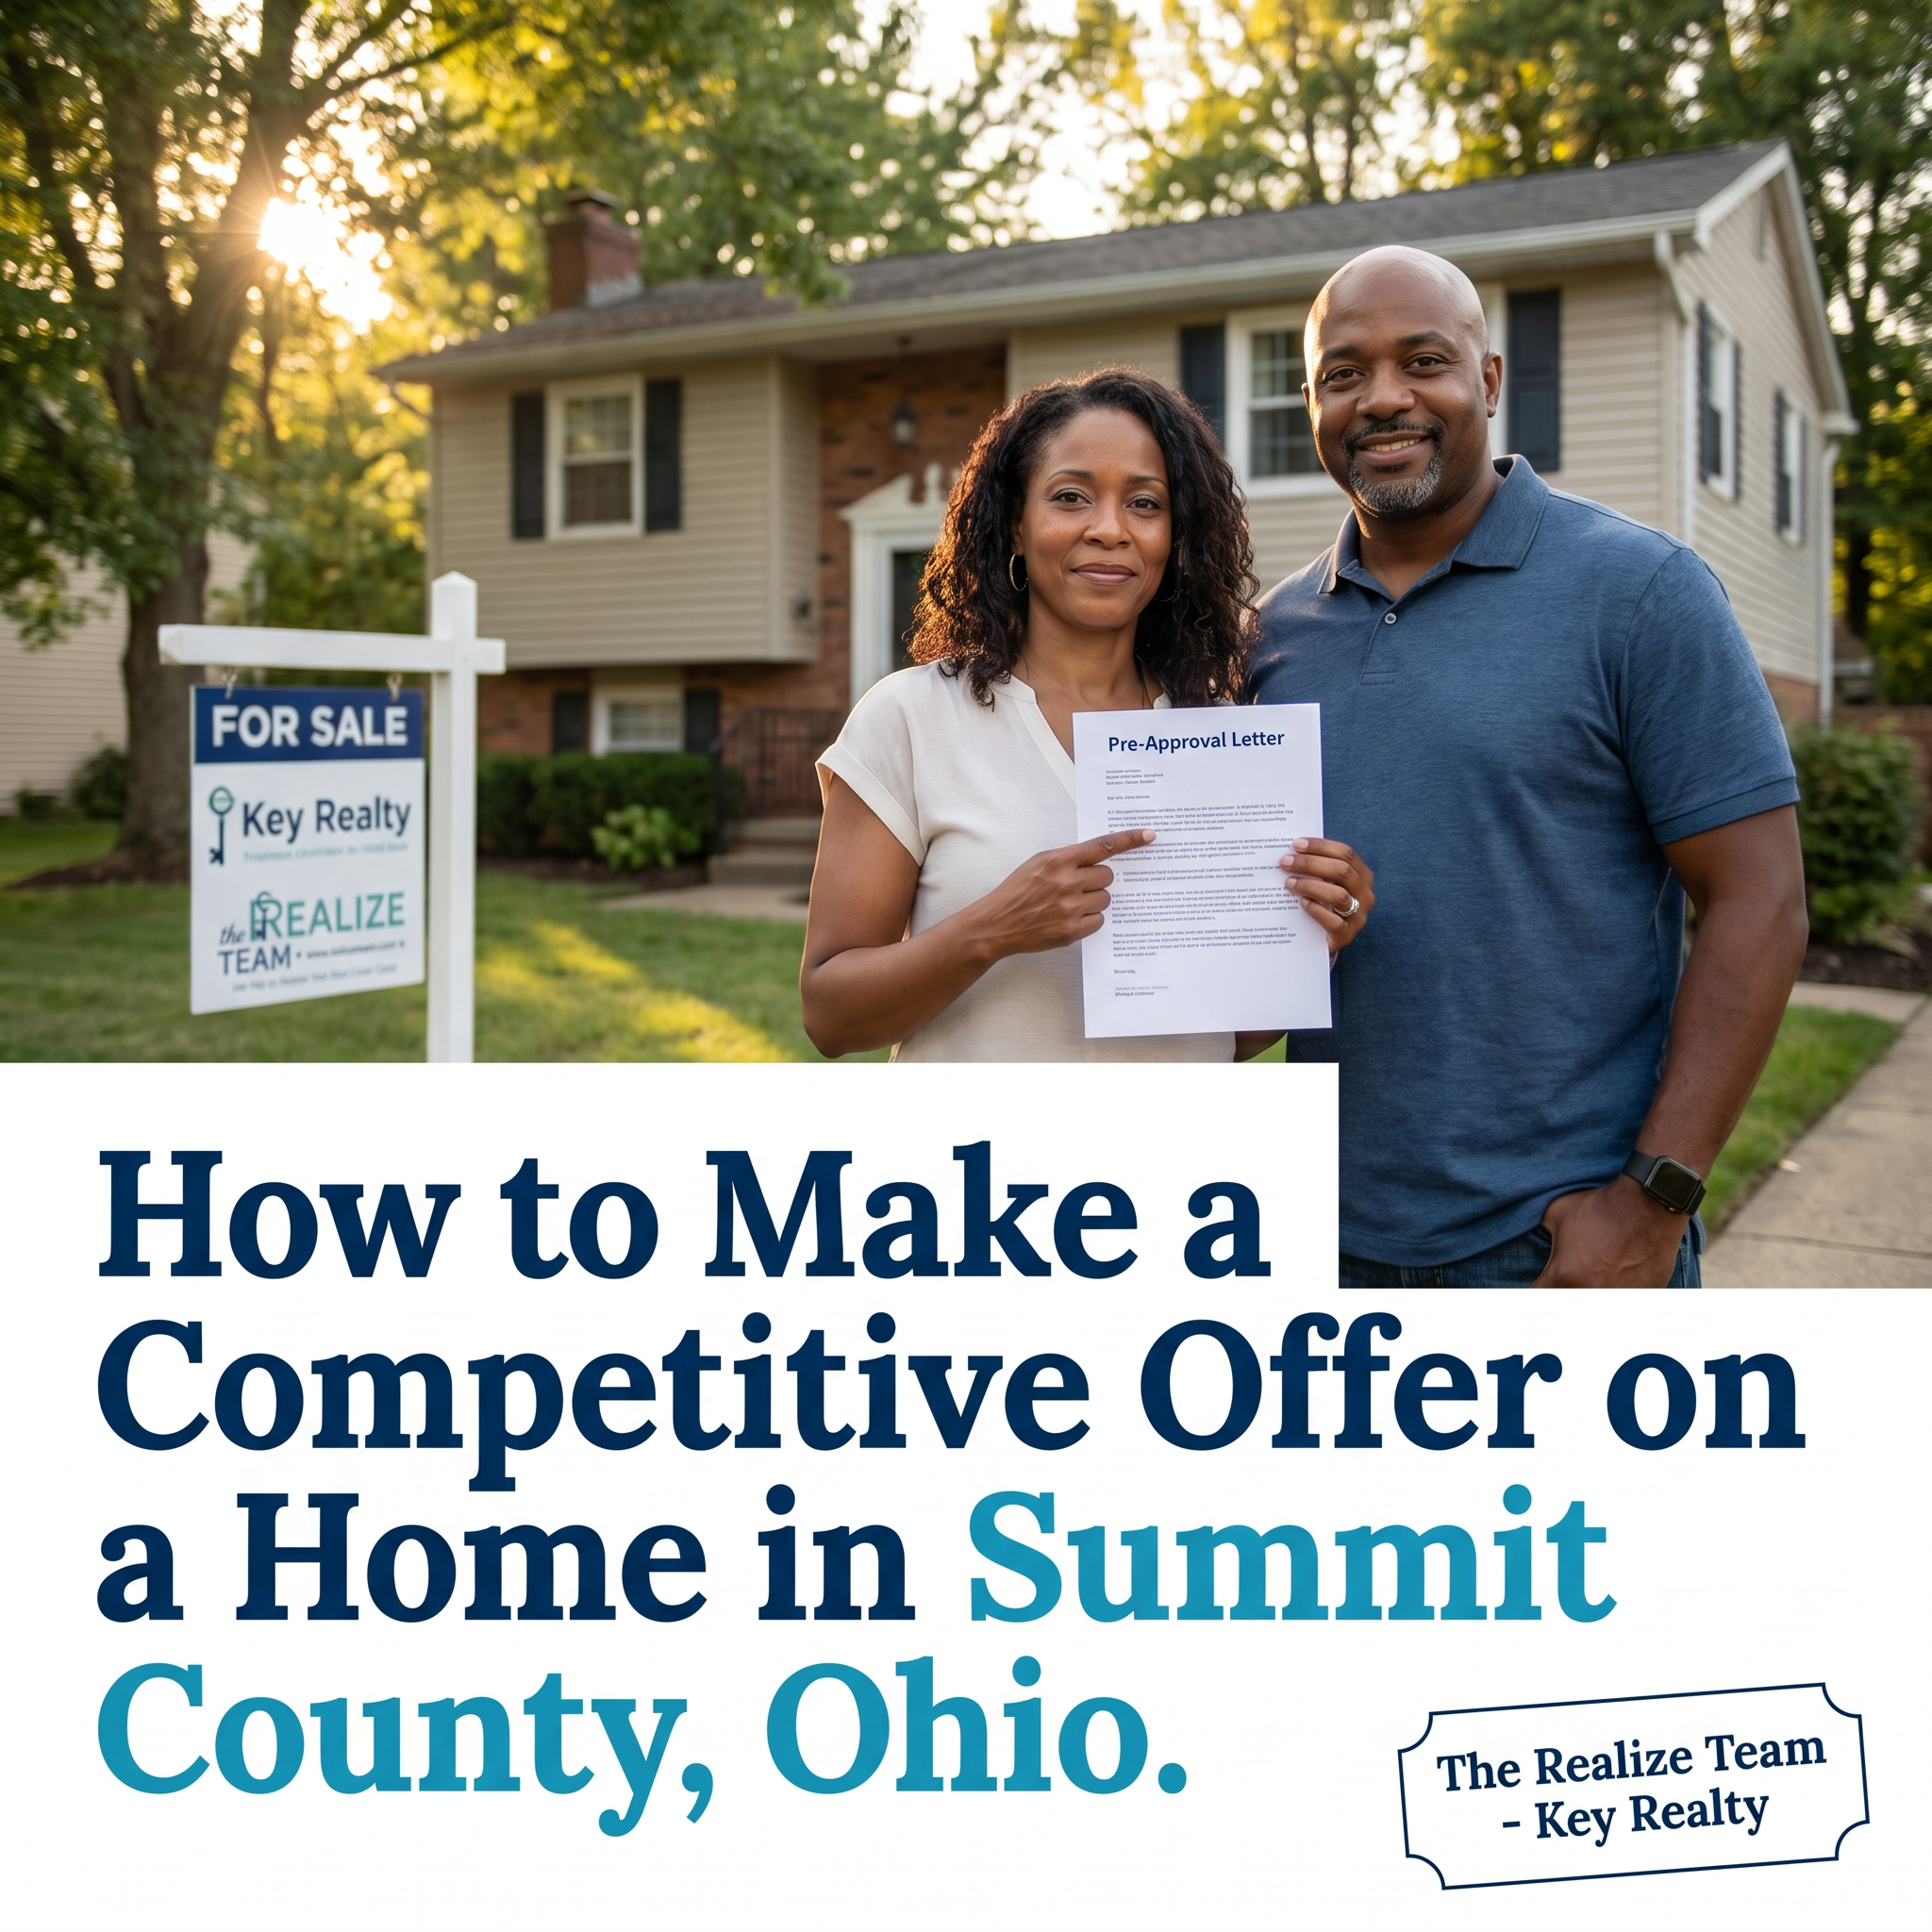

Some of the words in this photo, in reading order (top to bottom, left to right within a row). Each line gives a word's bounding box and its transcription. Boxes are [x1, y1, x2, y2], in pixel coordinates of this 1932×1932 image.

[212, 705, 299, 748] FOR
[310, 706, 408, 746] SALE
[1108, 731, 1227, 755] Pre-Approval
[1232, 731, 1286, 747] Letter
[242, 801, 304, 844] Key
[315, 796, 411, 837] Realty
[220, 923, 246, 946] the
[218, 943, 291, 975] TEAM
